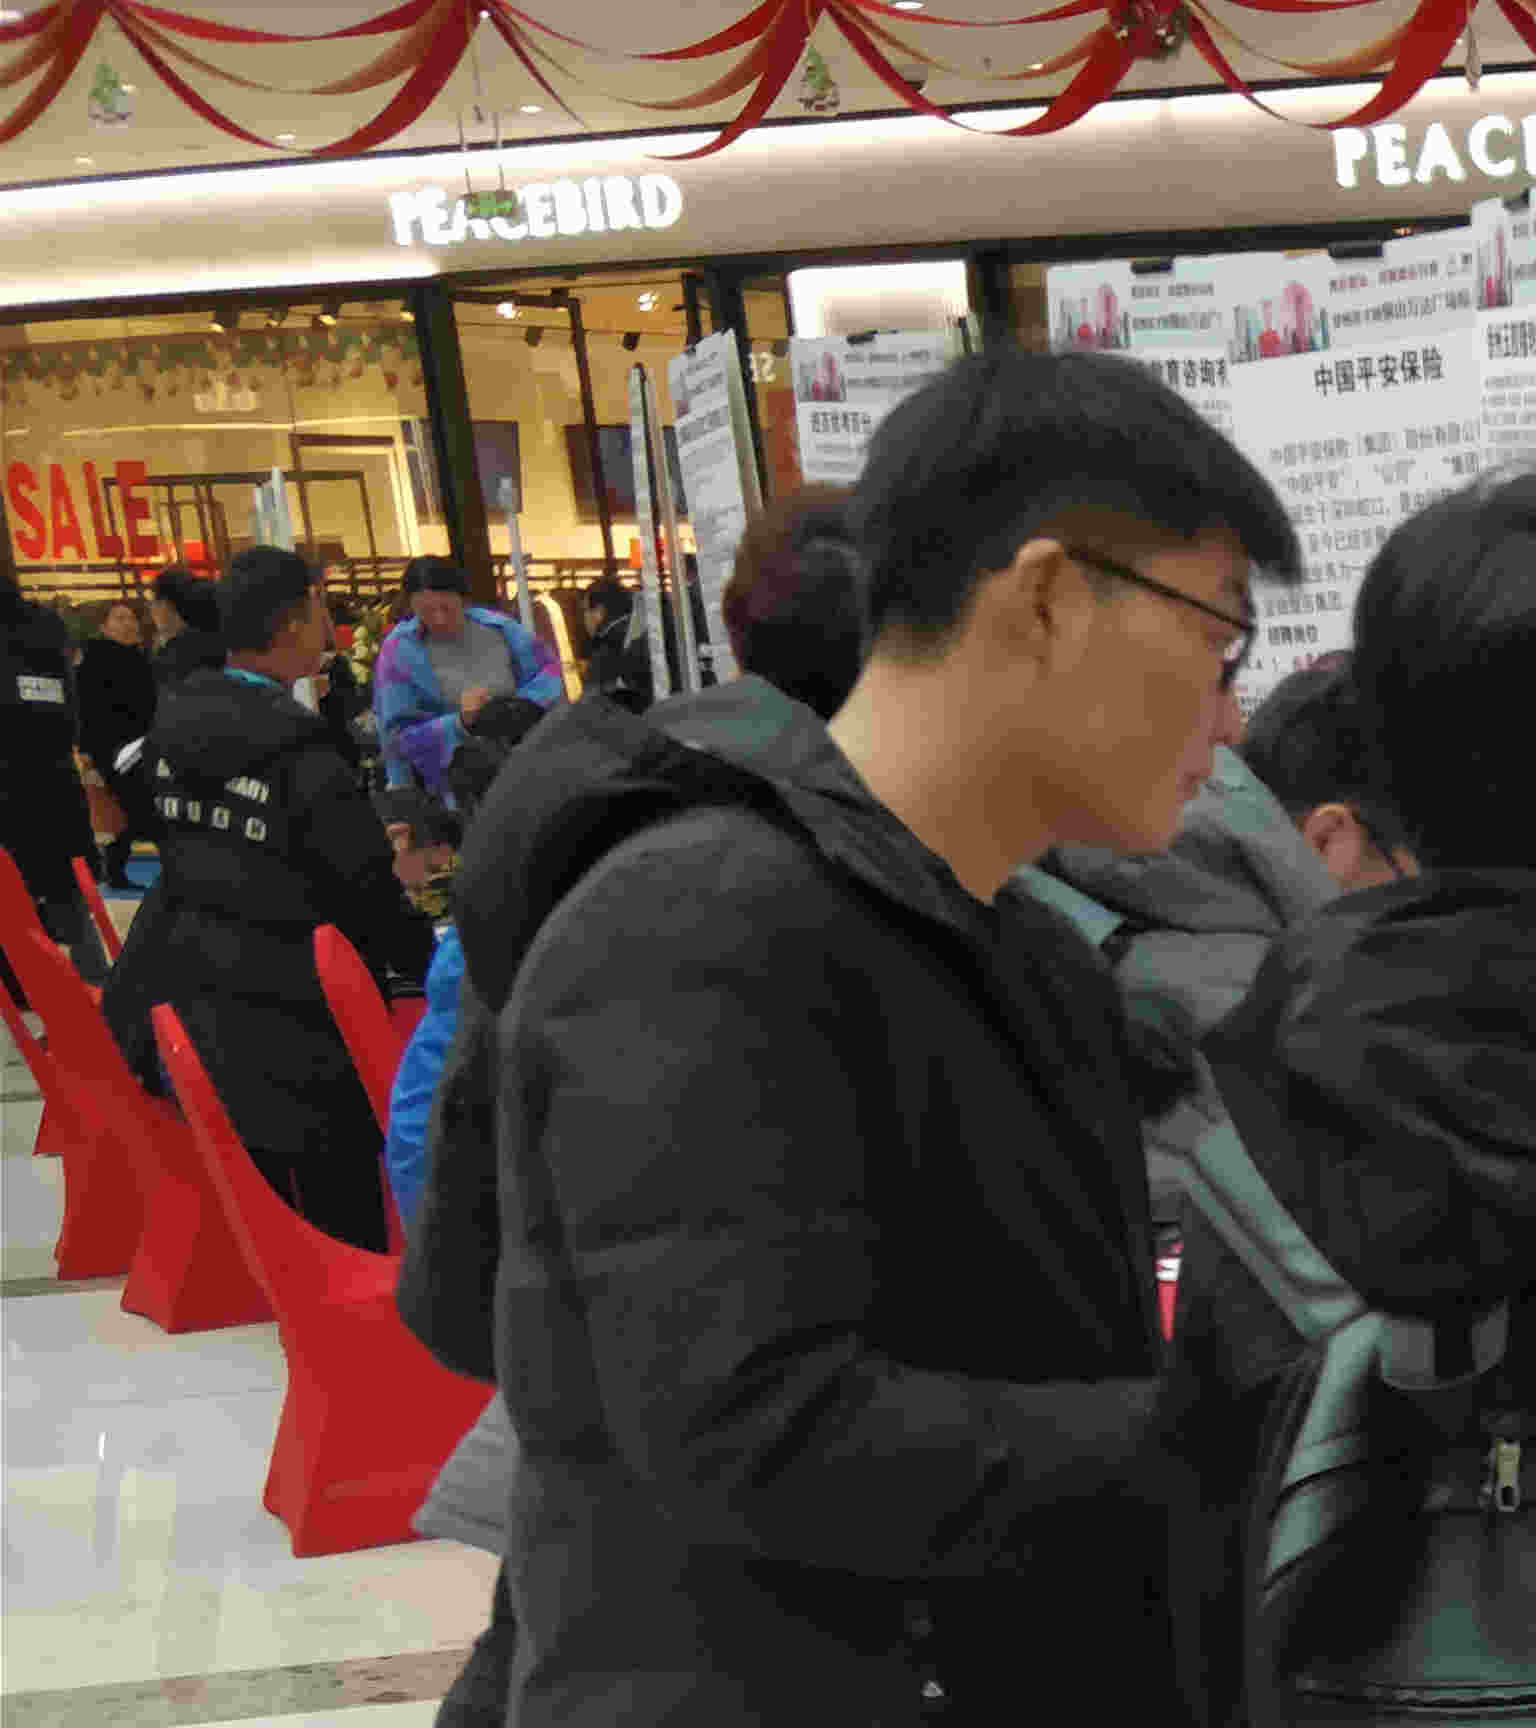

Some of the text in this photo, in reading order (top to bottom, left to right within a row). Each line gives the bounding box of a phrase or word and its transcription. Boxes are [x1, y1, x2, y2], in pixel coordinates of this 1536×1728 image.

[1314, 346, 1444, 397] 中国平安保险
[6, 459, 160, 561] SALE
